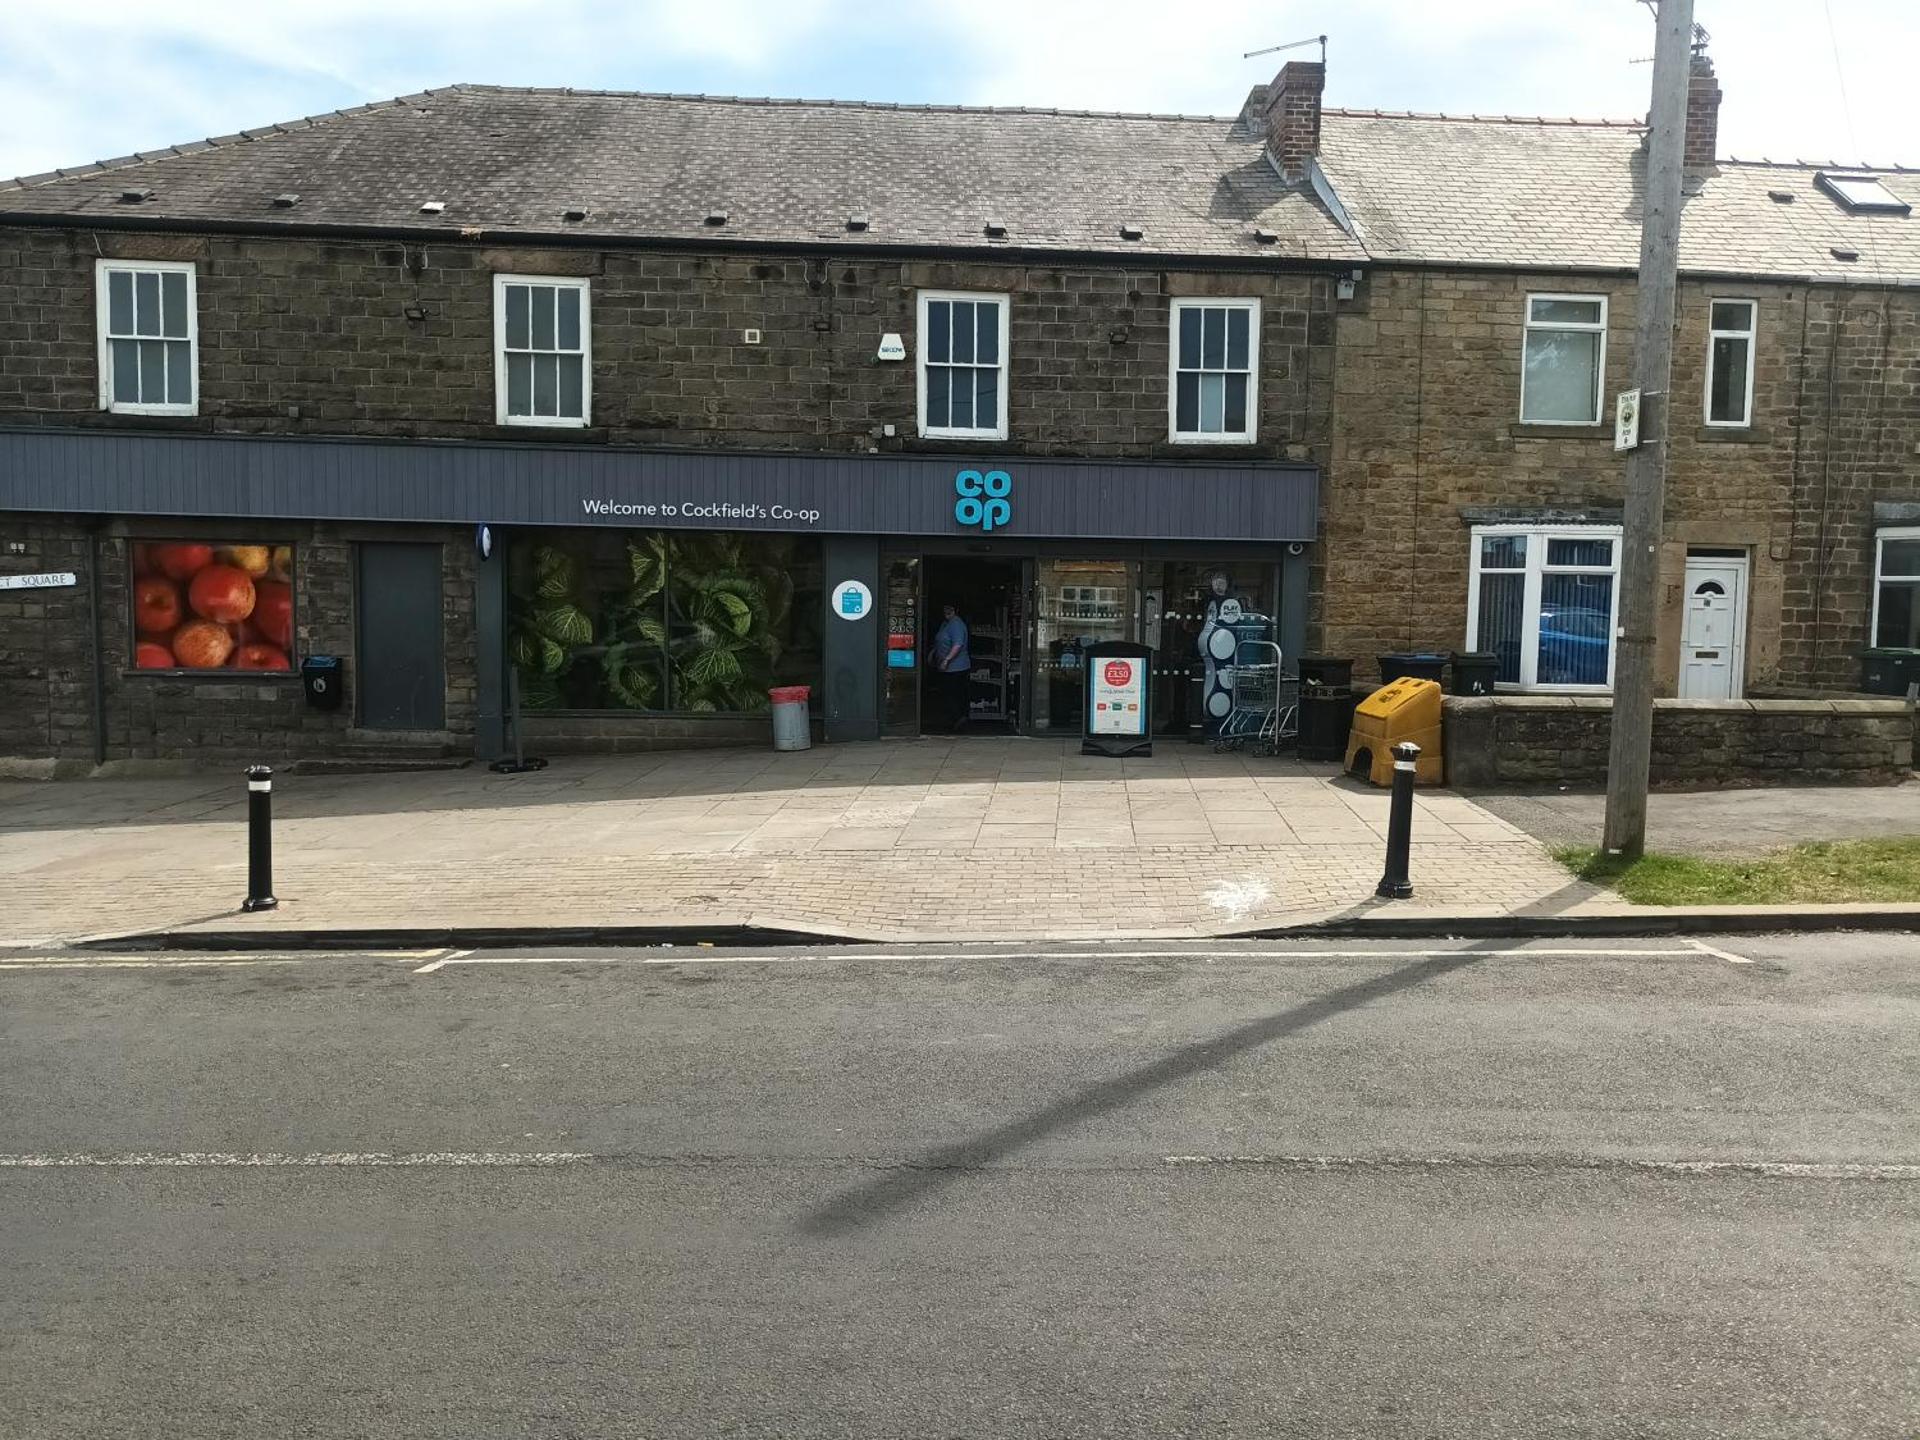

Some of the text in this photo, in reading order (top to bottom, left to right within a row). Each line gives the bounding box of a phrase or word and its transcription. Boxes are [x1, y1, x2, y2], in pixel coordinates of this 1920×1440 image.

[582, 499, 821, 524] Welcome to Cockfield's Co-op
[22, 574, 66, 586] SQUARE
